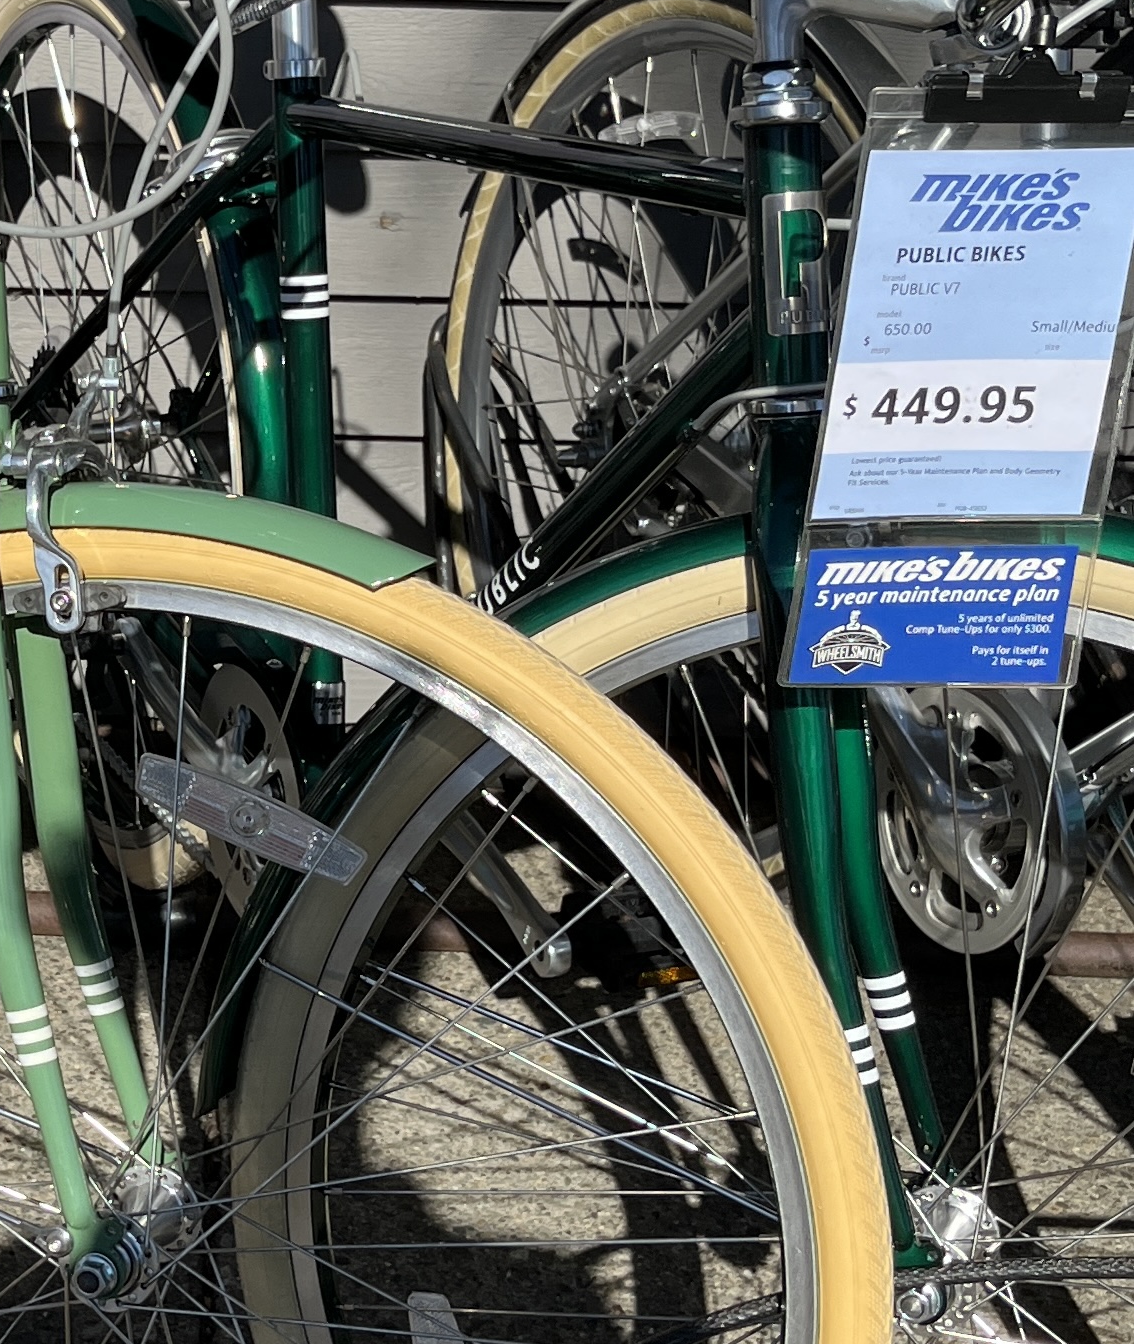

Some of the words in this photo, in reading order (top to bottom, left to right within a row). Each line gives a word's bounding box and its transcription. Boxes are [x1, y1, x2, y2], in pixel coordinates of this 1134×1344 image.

[896, 246, 966, 264] PUBLIC
[971, 245, 1027, 262] BIKES
[890, 282, 940, 296] PUBLIC
[944, 281, 961, 295] V7
[884, 322, 933, 336] 650.00
[1031, 320, 1116, 334] Small/Mediu
[863, 336, 870, 347] $
[842, 394, 858, 420] $
[871, 385, 1037, 425] 449.95
[477, 537, 541, 616] UBLIC
[814, 590, 830, 607] 5
[830, 588, 879, 611] year
[879, 585, 1011, 604] maintenance
[1012, 584, 1060, 607] plan
[958, 613, 965, 623] 5
[966, 614, 993, 625] years
[994, 613, 1007, 623] of
[1007, 612, 1055, 623] unlimited
[906, 624, 935, 636] Comp
[937, 624, 983, 636] Tune-Ups
[984, 623, 999, 634] for
[1001, 624, 1023, 636] only
[816, 643, 882, 663] WHEELSMITH
[971, 645, 995, 657] Pays
[996, 644, 1011, 655] for
[1012, 644, 1039, 655] itself
[1039, 644, 1049, 655] in
[991, 656, 999, 666] 2
